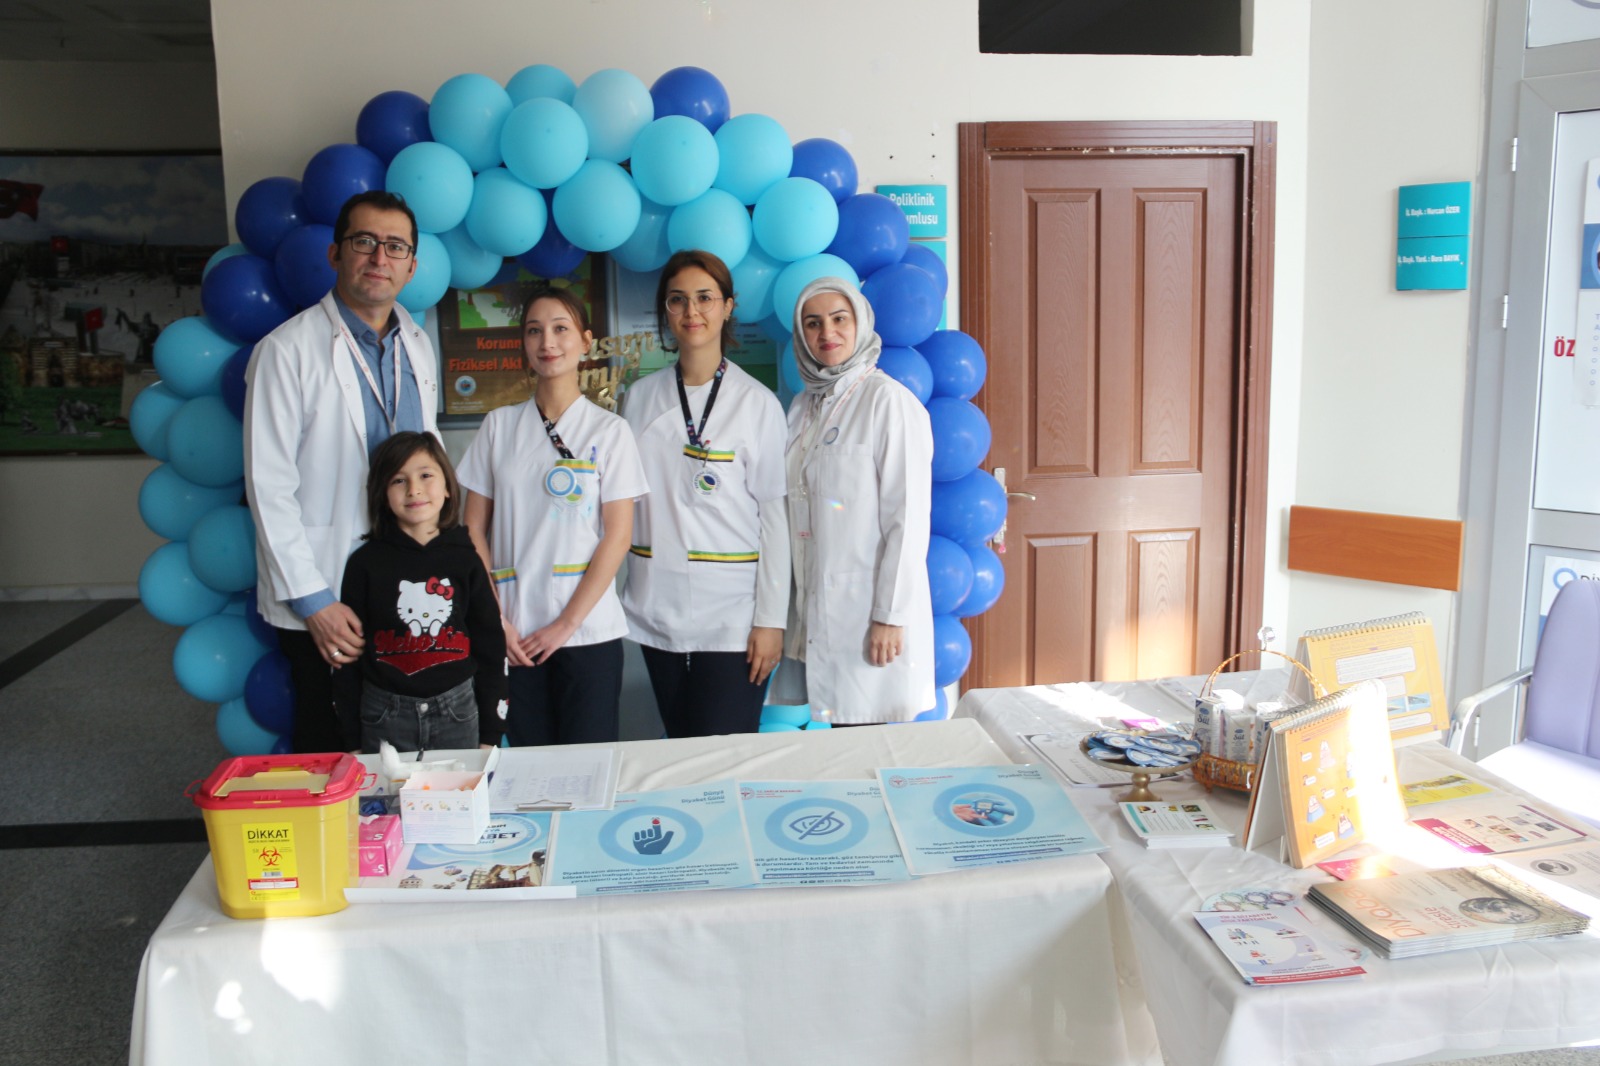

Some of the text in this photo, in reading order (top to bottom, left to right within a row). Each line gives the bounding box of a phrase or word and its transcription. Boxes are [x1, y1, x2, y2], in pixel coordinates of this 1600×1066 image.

[890, 193, 935, 206] Poliklinik
[449, 358, 498, 372] Fiziksel
[248, 828, 289, 840] DİKKAT
[373, 833, 384, 841] S
[377, 864, 385, 873] S
